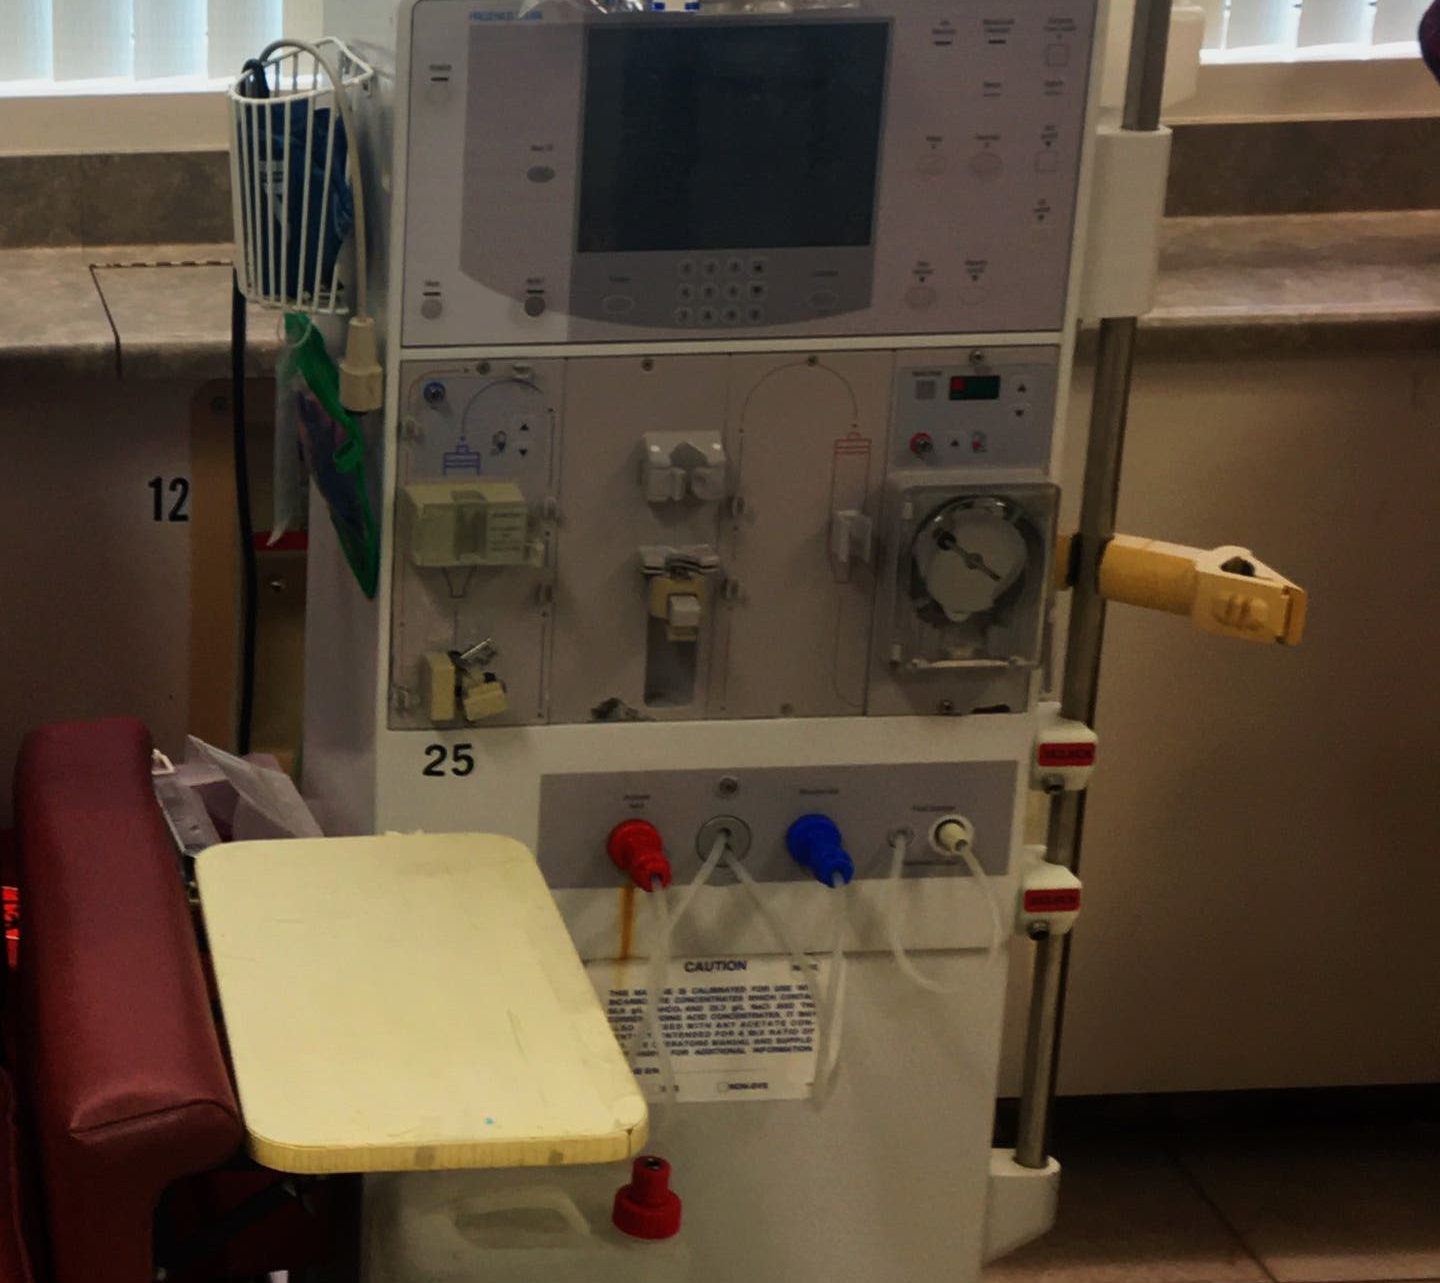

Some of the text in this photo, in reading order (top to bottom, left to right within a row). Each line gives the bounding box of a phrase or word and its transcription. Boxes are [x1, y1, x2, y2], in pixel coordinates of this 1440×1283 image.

[148, 476, 189, 522] 12
[422, 743, 474, 777] 25
[684, 960, 747, 972] CAUTION
